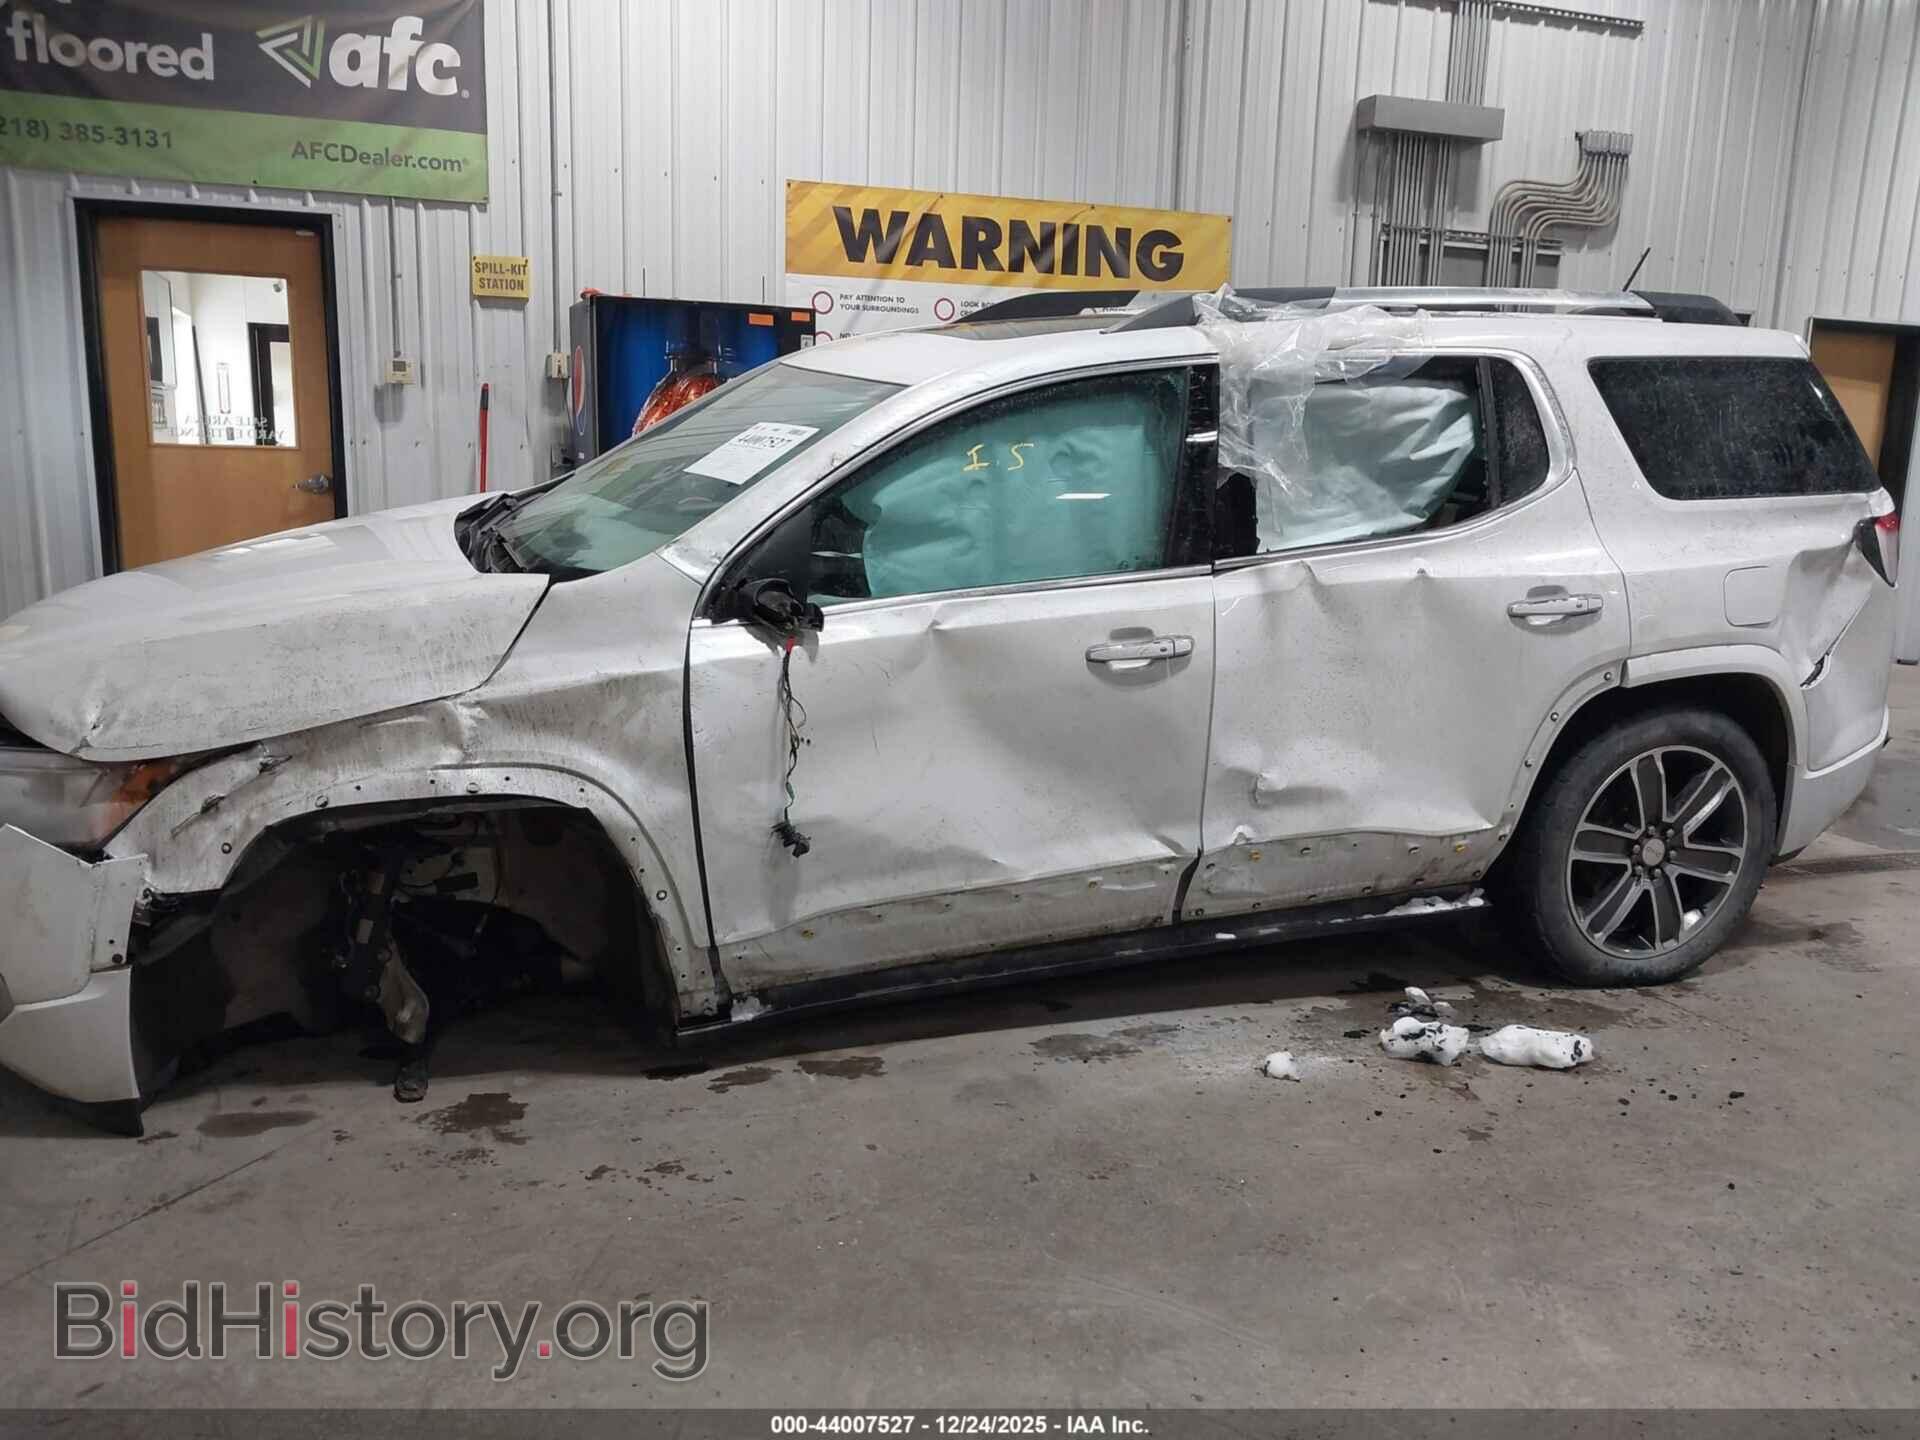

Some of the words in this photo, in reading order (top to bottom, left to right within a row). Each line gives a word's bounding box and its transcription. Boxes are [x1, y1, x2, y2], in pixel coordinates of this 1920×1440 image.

[5, 10, 215, 81] floored
[59, 121, 173, 149] 385-3131
[832, 206, 1185, 282] WARNING
[474, 261, 528, 275] SPILL-KIT
[479, 276, 524, 291] STATION
[840, 293, 853, 301] PAY
[856, 294, 893, 303] ATTENTION
[840, 303, 860, 311] YOUR
[861, 304, 919, 314] SURROUNDINGS
